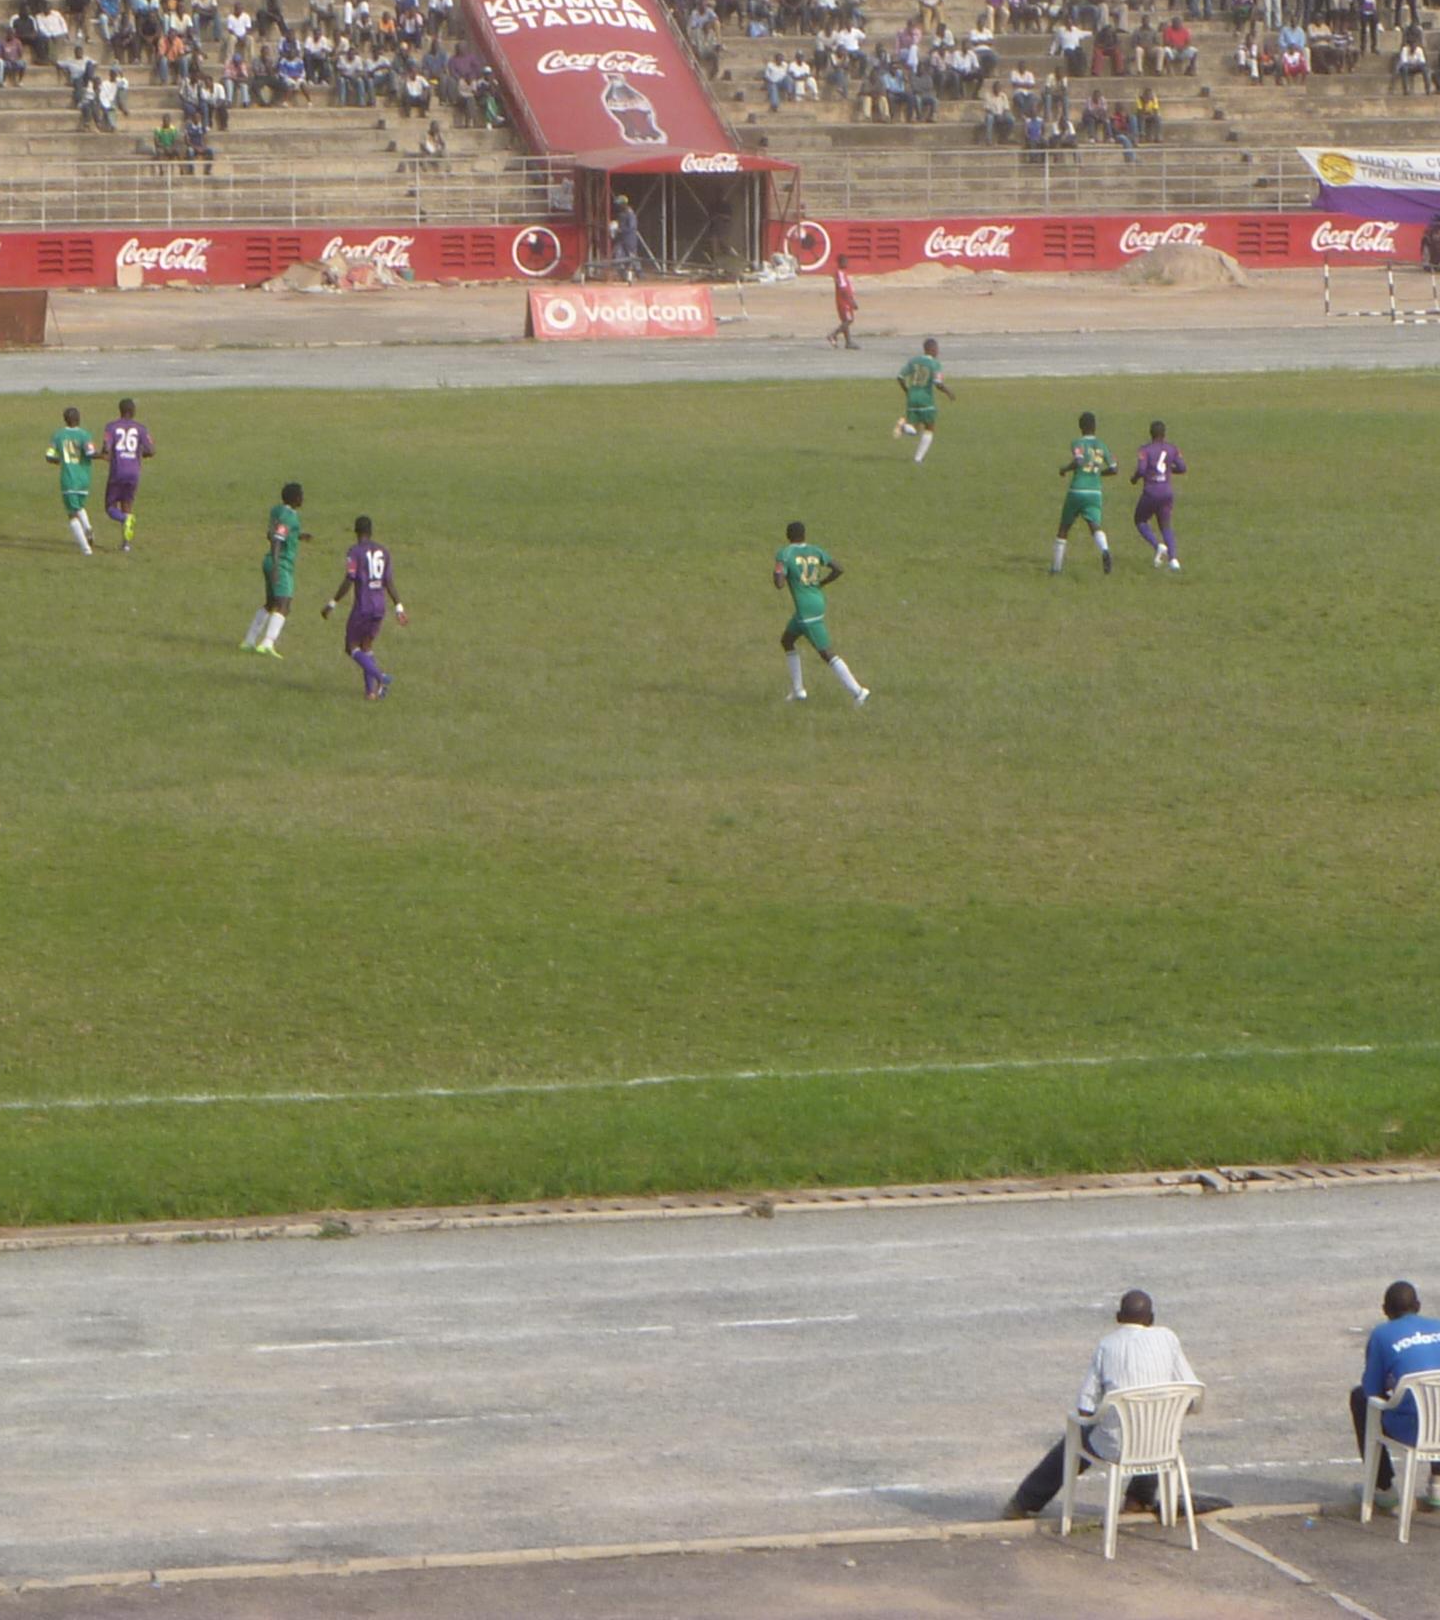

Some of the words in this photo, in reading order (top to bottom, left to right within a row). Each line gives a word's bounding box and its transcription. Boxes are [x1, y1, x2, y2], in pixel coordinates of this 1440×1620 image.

[492, 9, 657, 34] STADIUM
[537, 49, 664, 77] Coca-Cola
[680, 152, 743, 174] Coca-Cola
[924, 226, 1015, 258] Coca-Cola
[1311, 220, 1400, 252] Coca-Cola
[116, 238, 212, 273] Coca-Cola
[584, 302, 702, 322] vodacom
[115, 427, 138, 453] 26
[1156, 450, 1168, 474] 6
[365, 549, 385, 580] 16
